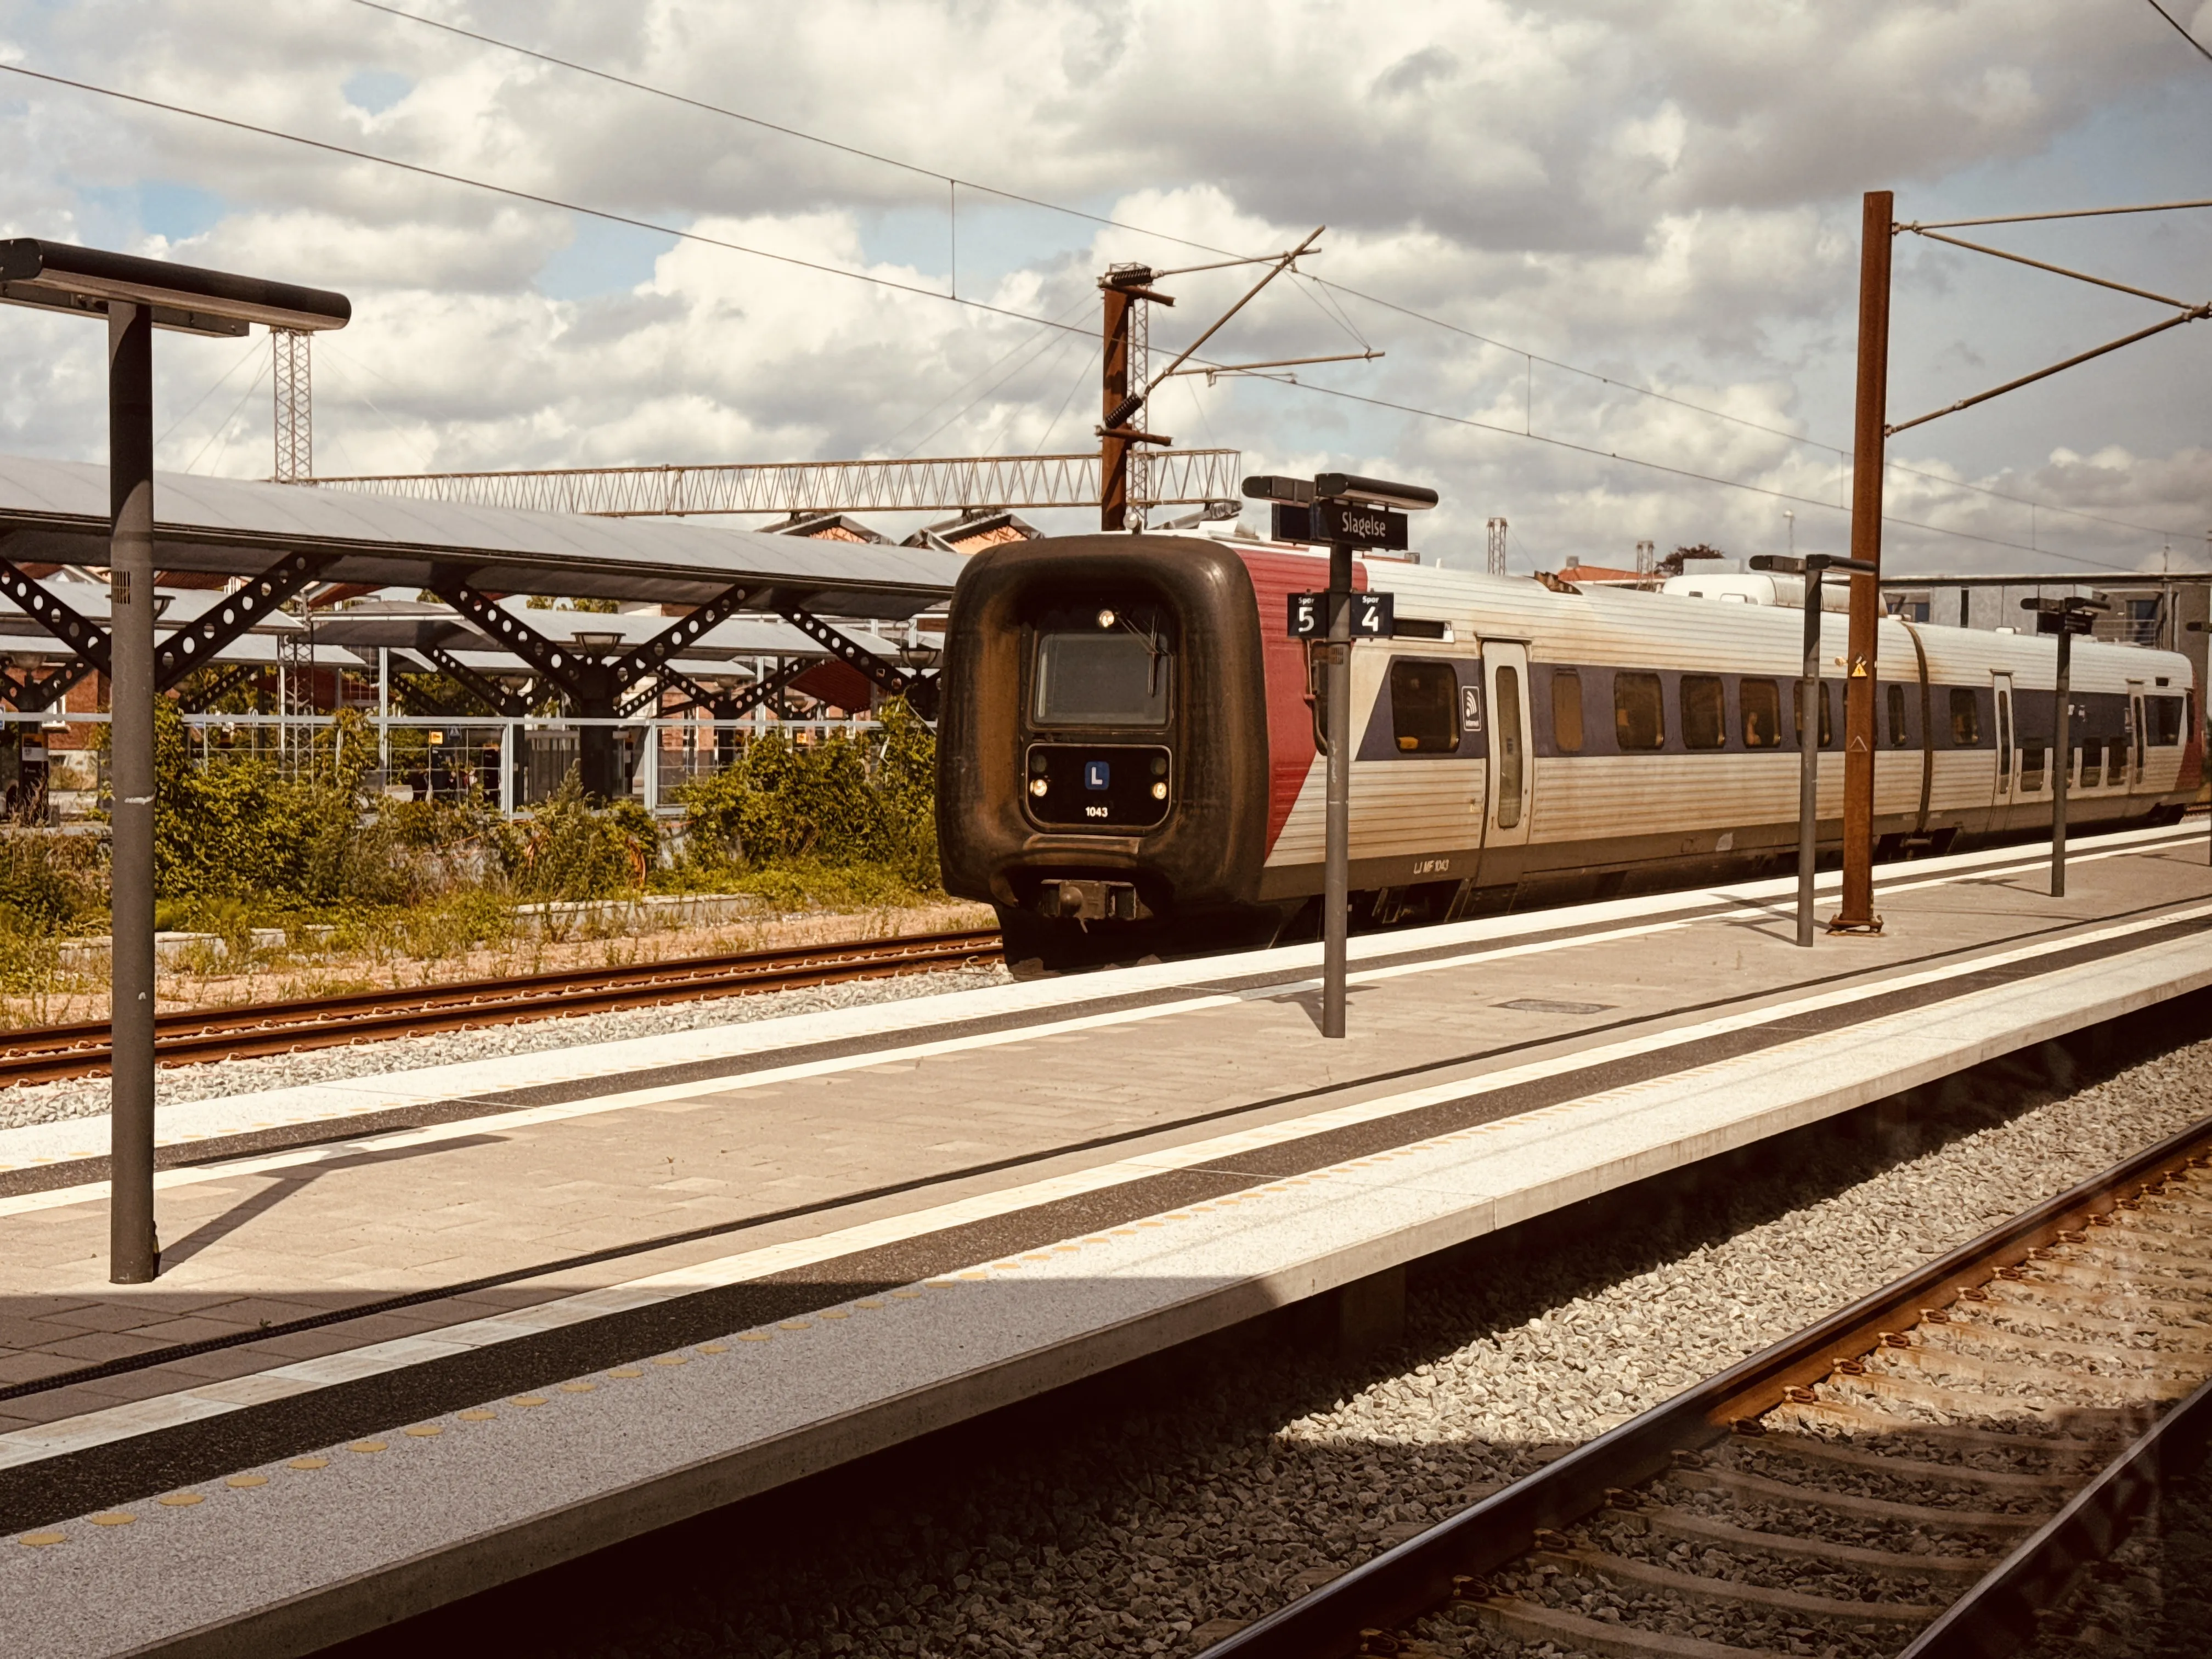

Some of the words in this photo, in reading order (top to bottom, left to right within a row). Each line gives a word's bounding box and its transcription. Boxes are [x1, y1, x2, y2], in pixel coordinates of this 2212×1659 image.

[1342, 511, 1386, 538] Slagelse
[1298, 596, 1314, 605] Spor
[1362, 595, 1379, 605] Spor
[1298, 607, 1314, 632] 5
[1362, 606, 1379, 632] 4
[1091, 766, 1103, 785] L
[1085, 806, 1108, 817] 1043
